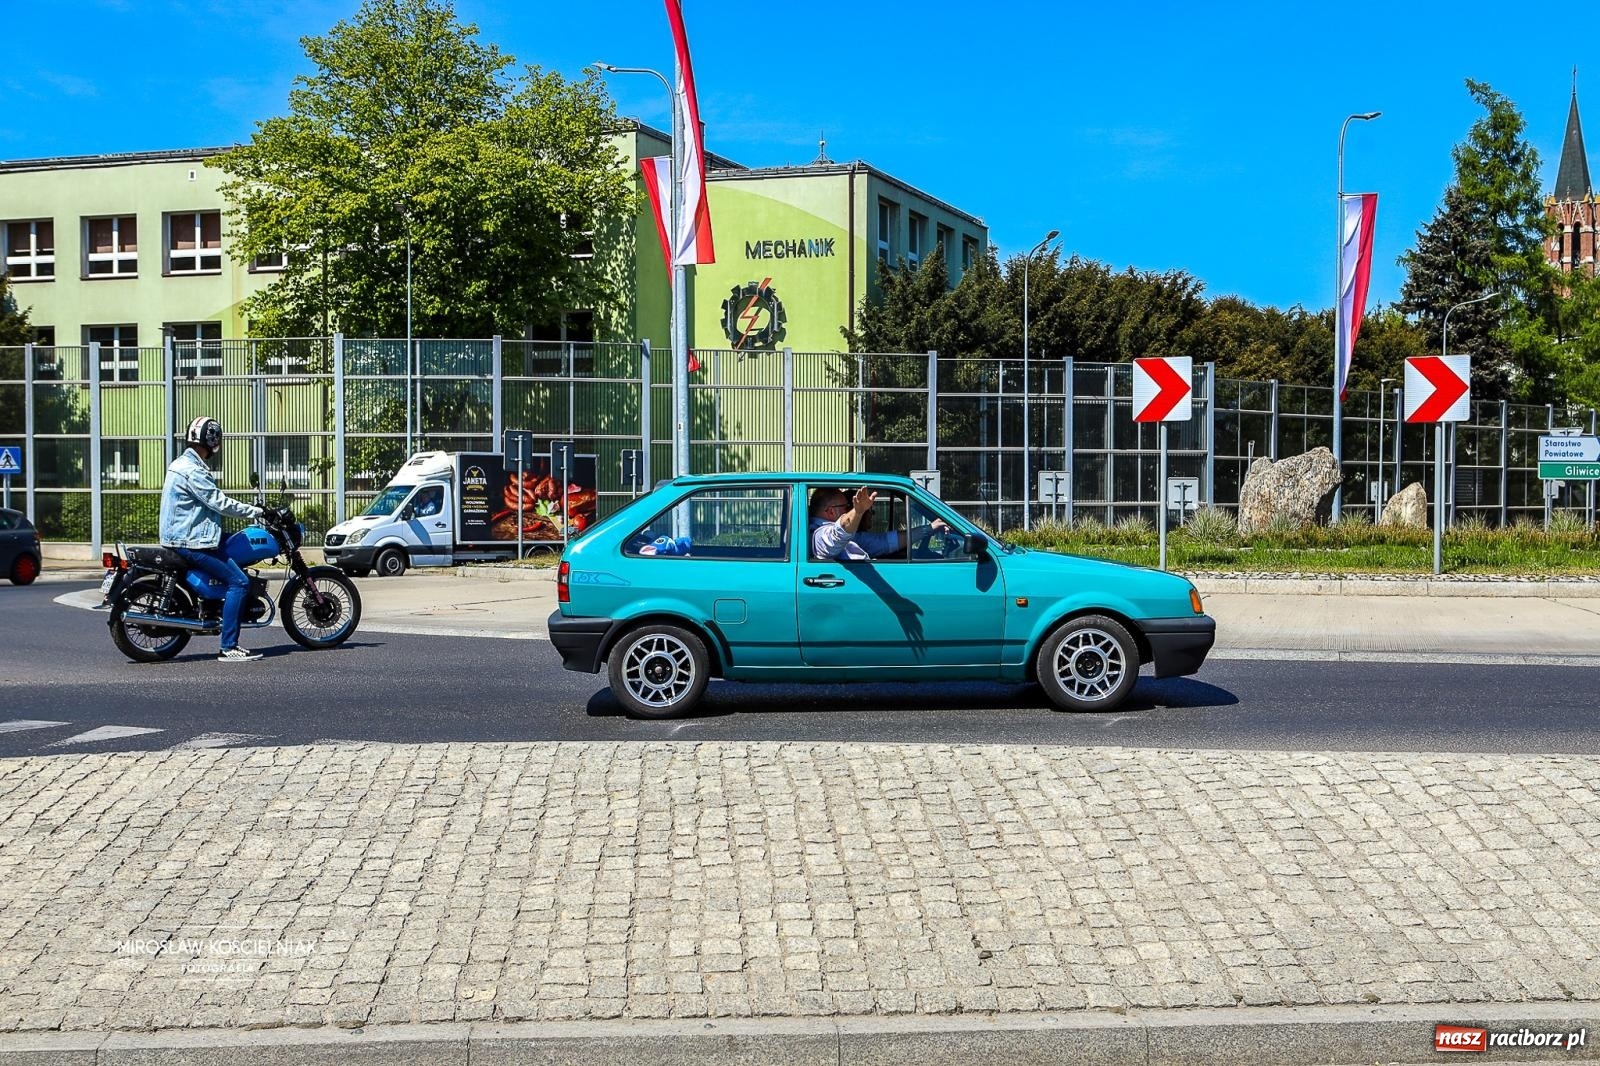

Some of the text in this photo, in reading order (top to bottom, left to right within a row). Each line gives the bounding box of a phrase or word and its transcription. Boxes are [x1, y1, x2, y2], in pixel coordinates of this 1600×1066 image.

[745, 238, 835, 259] MECHANIK
[1544, 439, 1582, 447] Starostwo
[1544, 449, 1584, 457] Powiatowe
[1565, 466, 1600, 476] Gliwice
[463, 477, 487, 485] JAKETA
